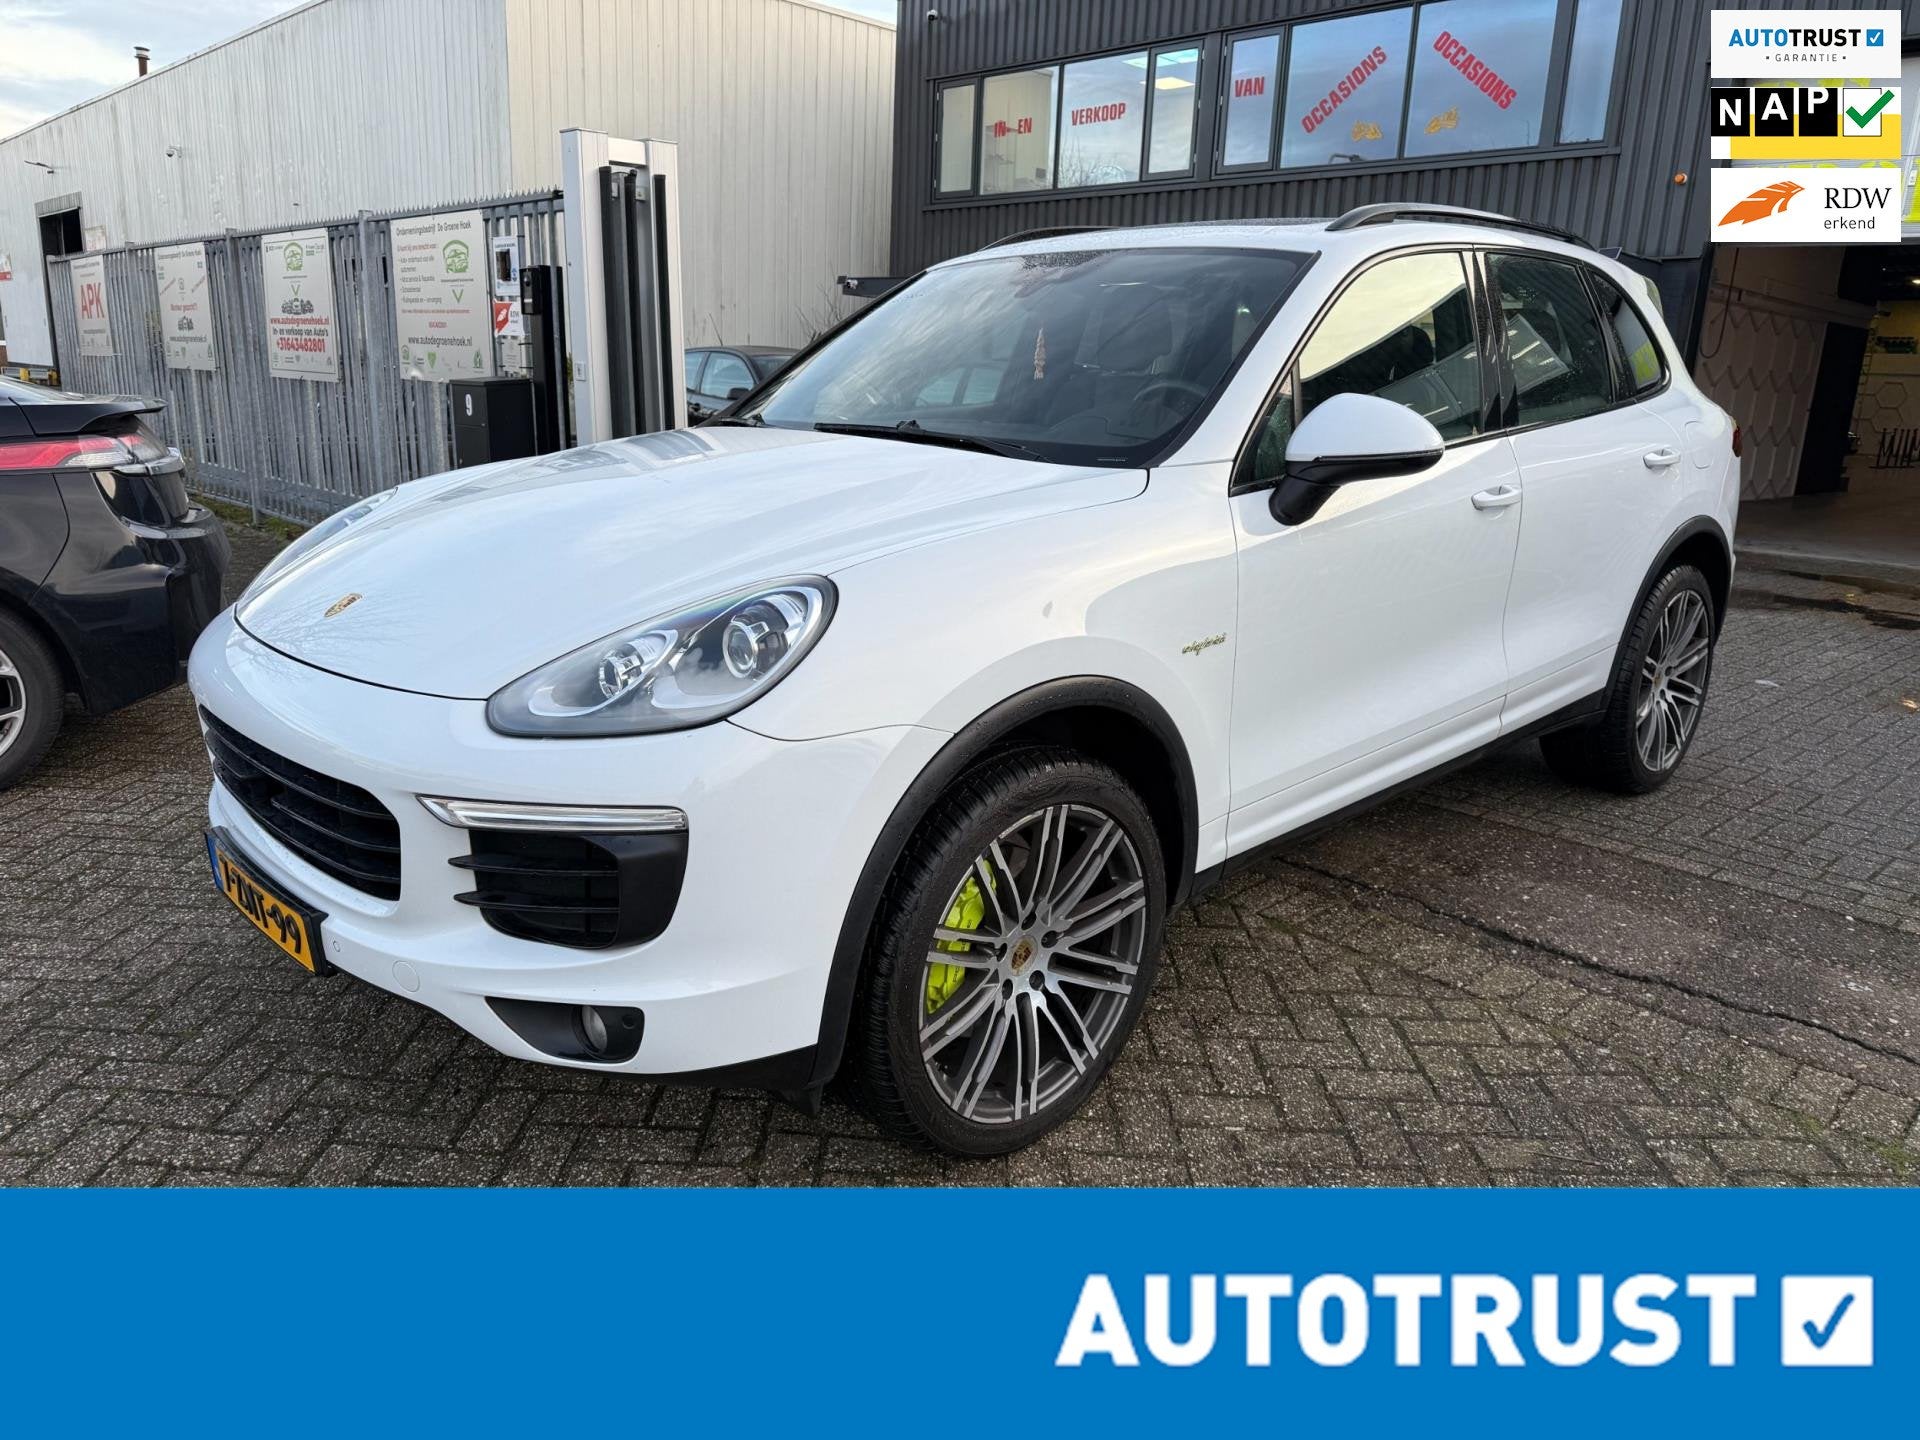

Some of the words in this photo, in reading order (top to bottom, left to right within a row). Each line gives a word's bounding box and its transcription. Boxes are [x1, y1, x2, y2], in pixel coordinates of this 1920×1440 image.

[1433, 31, 1517, 110] OCCASIONS
[1018, 117, 1032, 135] EN
[1071, 102, 1126, 126] VERKOOP
[1235, 76, 1265, 97] VAN
[1302, 46, 1387, 134] OCCASIONS
[437, 223, 443, 232] De
[444, 222, 459, 232] Groene
[460, 220, 471, 230] Hoek
[80, 282, 105, 320] APK
[276, 338, 326, 353] +31643482801
[465, 393, 473, 417] 9
